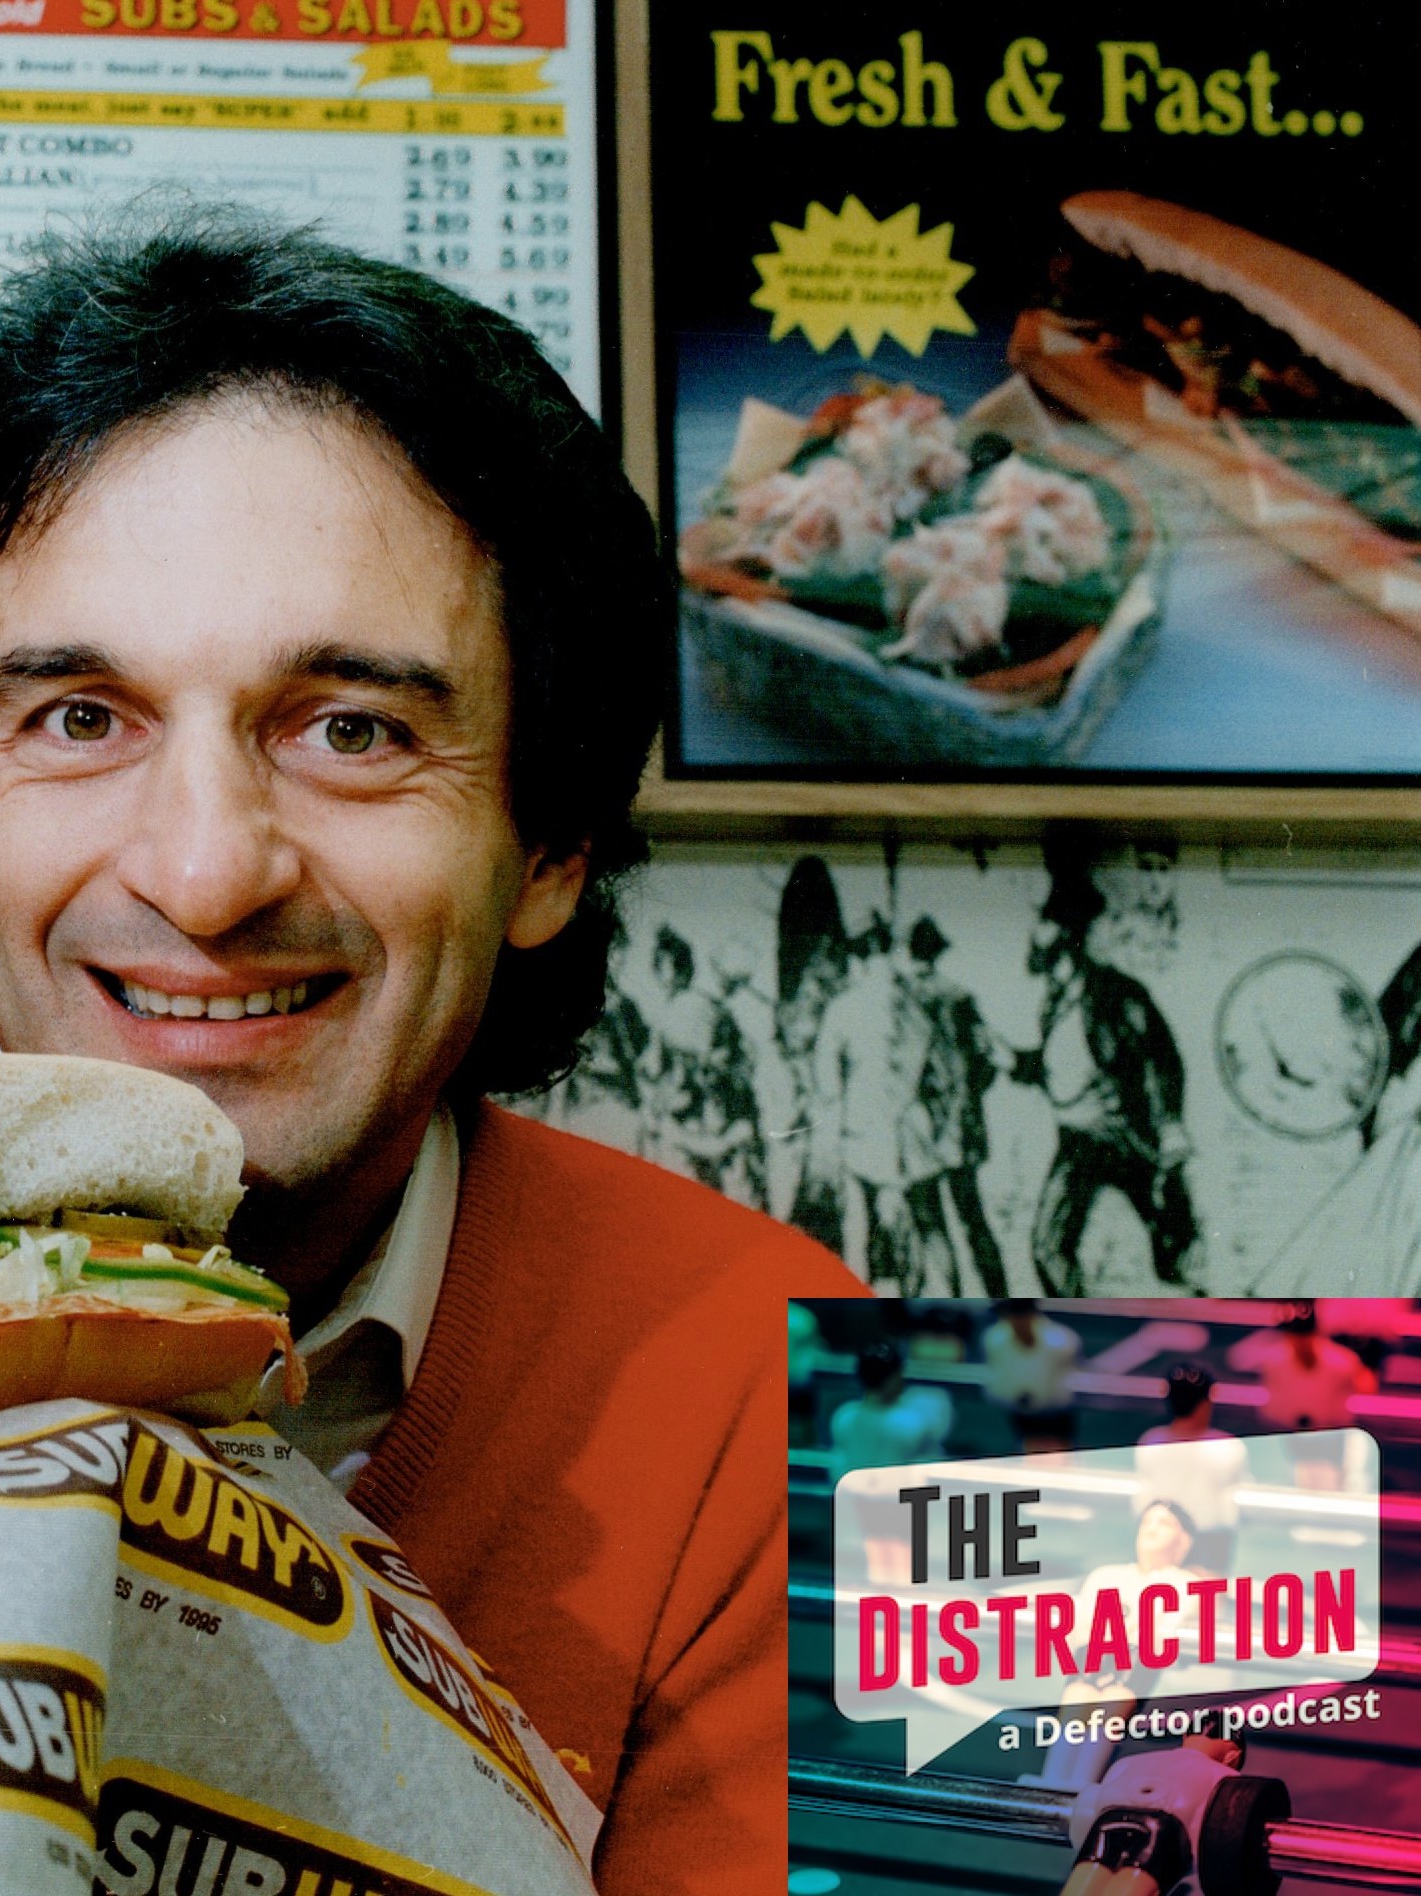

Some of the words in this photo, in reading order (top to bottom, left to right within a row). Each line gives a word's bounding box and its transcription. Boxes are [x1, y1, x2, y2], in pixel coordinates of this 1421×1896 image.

[81, 0, 240, 32] SUBS
[250, 3, 280, 34] &
[297, 0, 525, 40] SALADS
[710, 31, 958, 128] Fresh
[985, 37, 1066, 132] &
[1097, 41, 1366, 137] Fast...
[18, 132, 134, 156] COMBO
[214, 1440, 266, 1459] STORES
[273, 1446, 294, 1461] BY
[139, 1590, 170, 1614] BY
[177, 1604, 222, 1637] 1995
